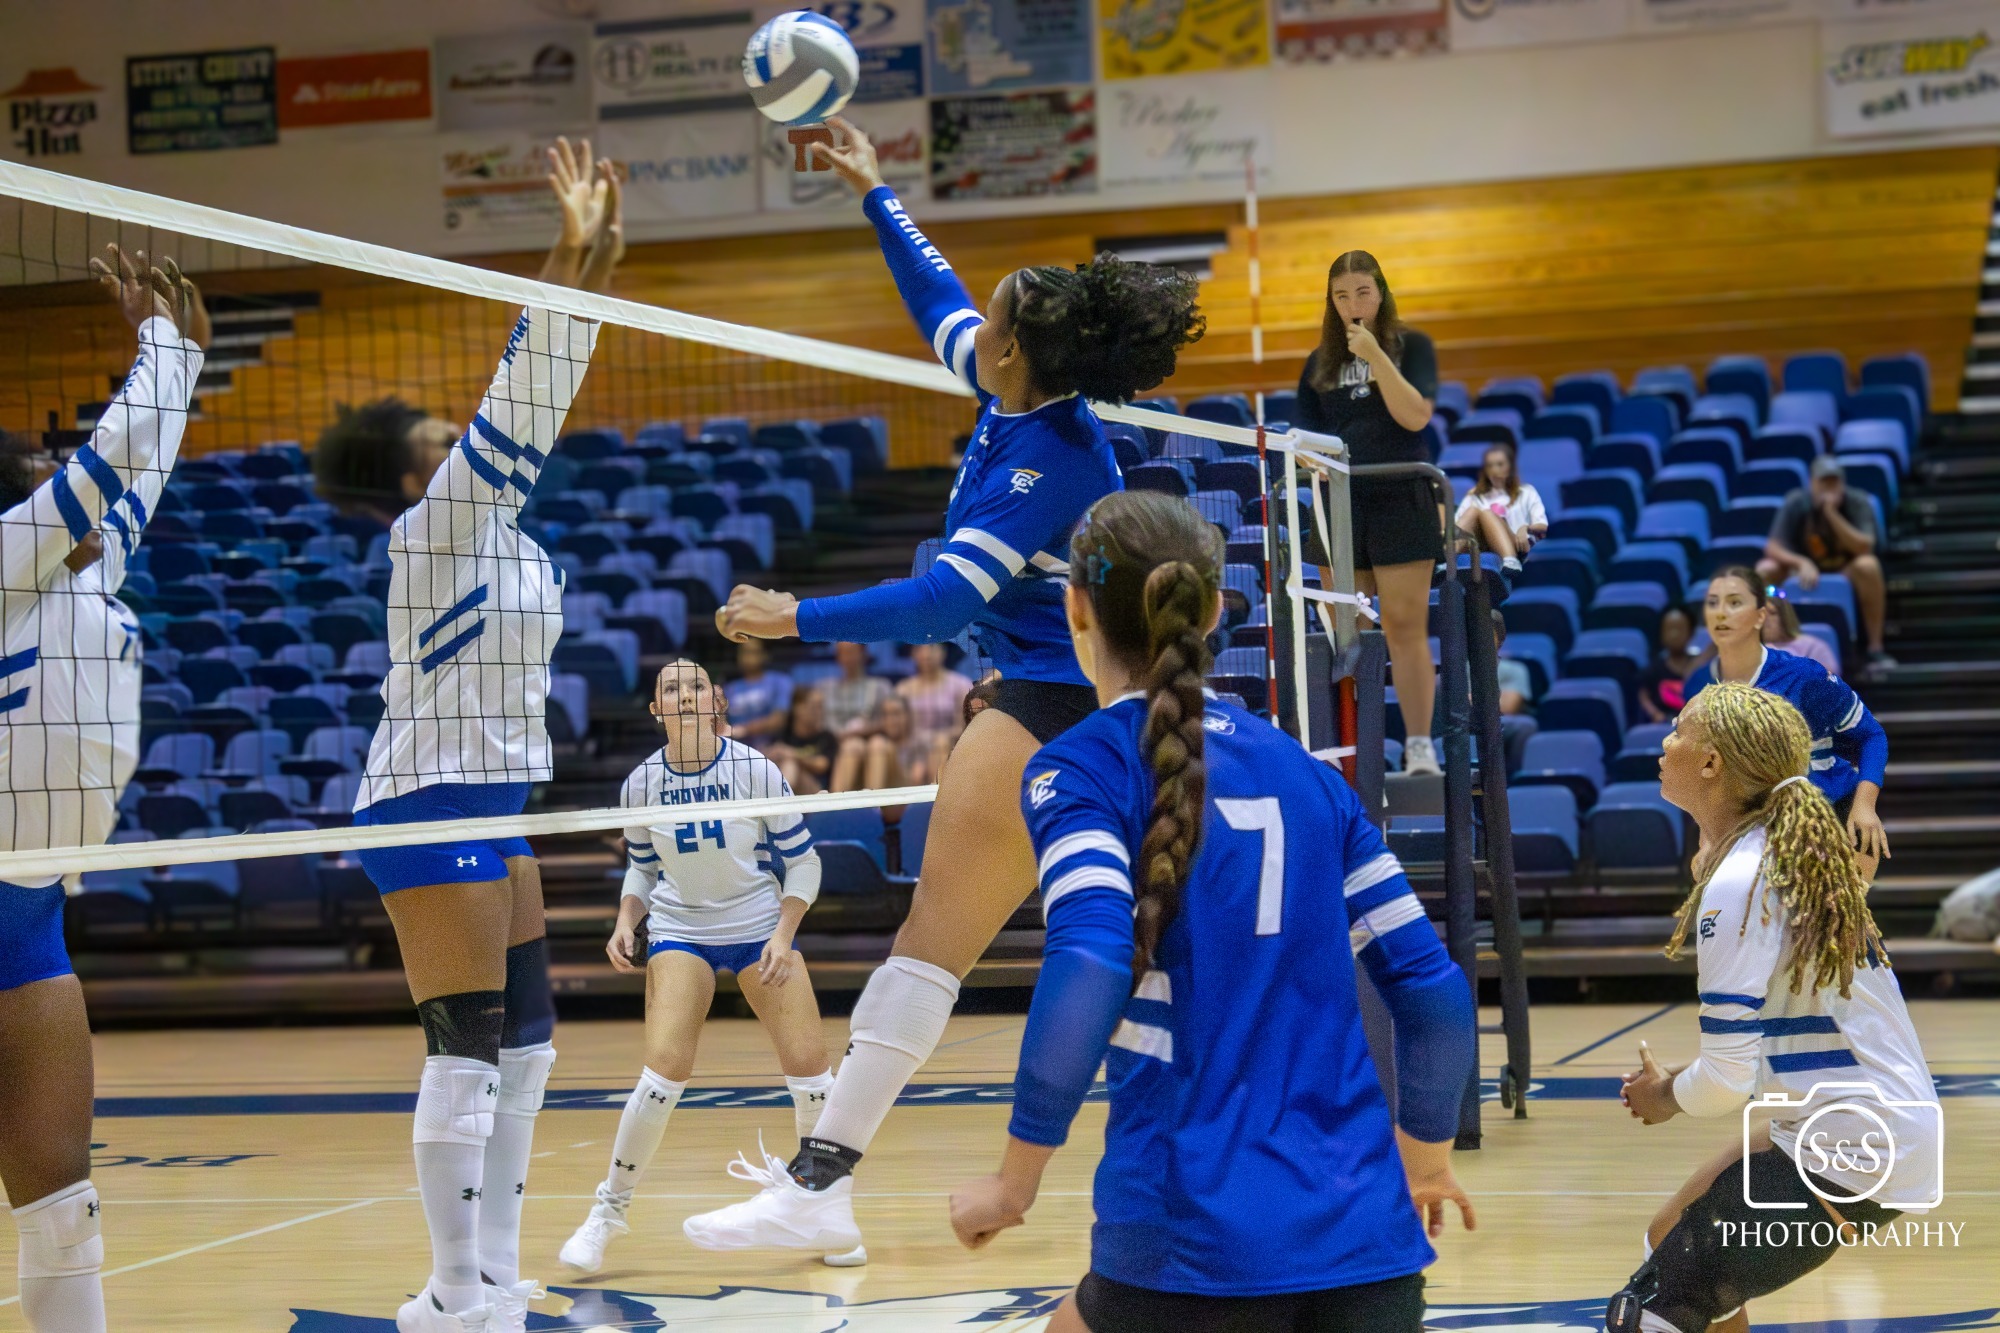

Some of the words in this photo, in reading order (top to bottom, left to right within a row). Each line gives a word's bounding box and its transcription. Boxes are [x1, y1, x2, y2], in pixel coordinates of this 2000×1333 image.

[1860, 90, 1909, 120] eat
[660, 784, 730, 806] CHOWAN
[675, 820, 726, 854] 24
[1213, 796, 1286, 936] 7
